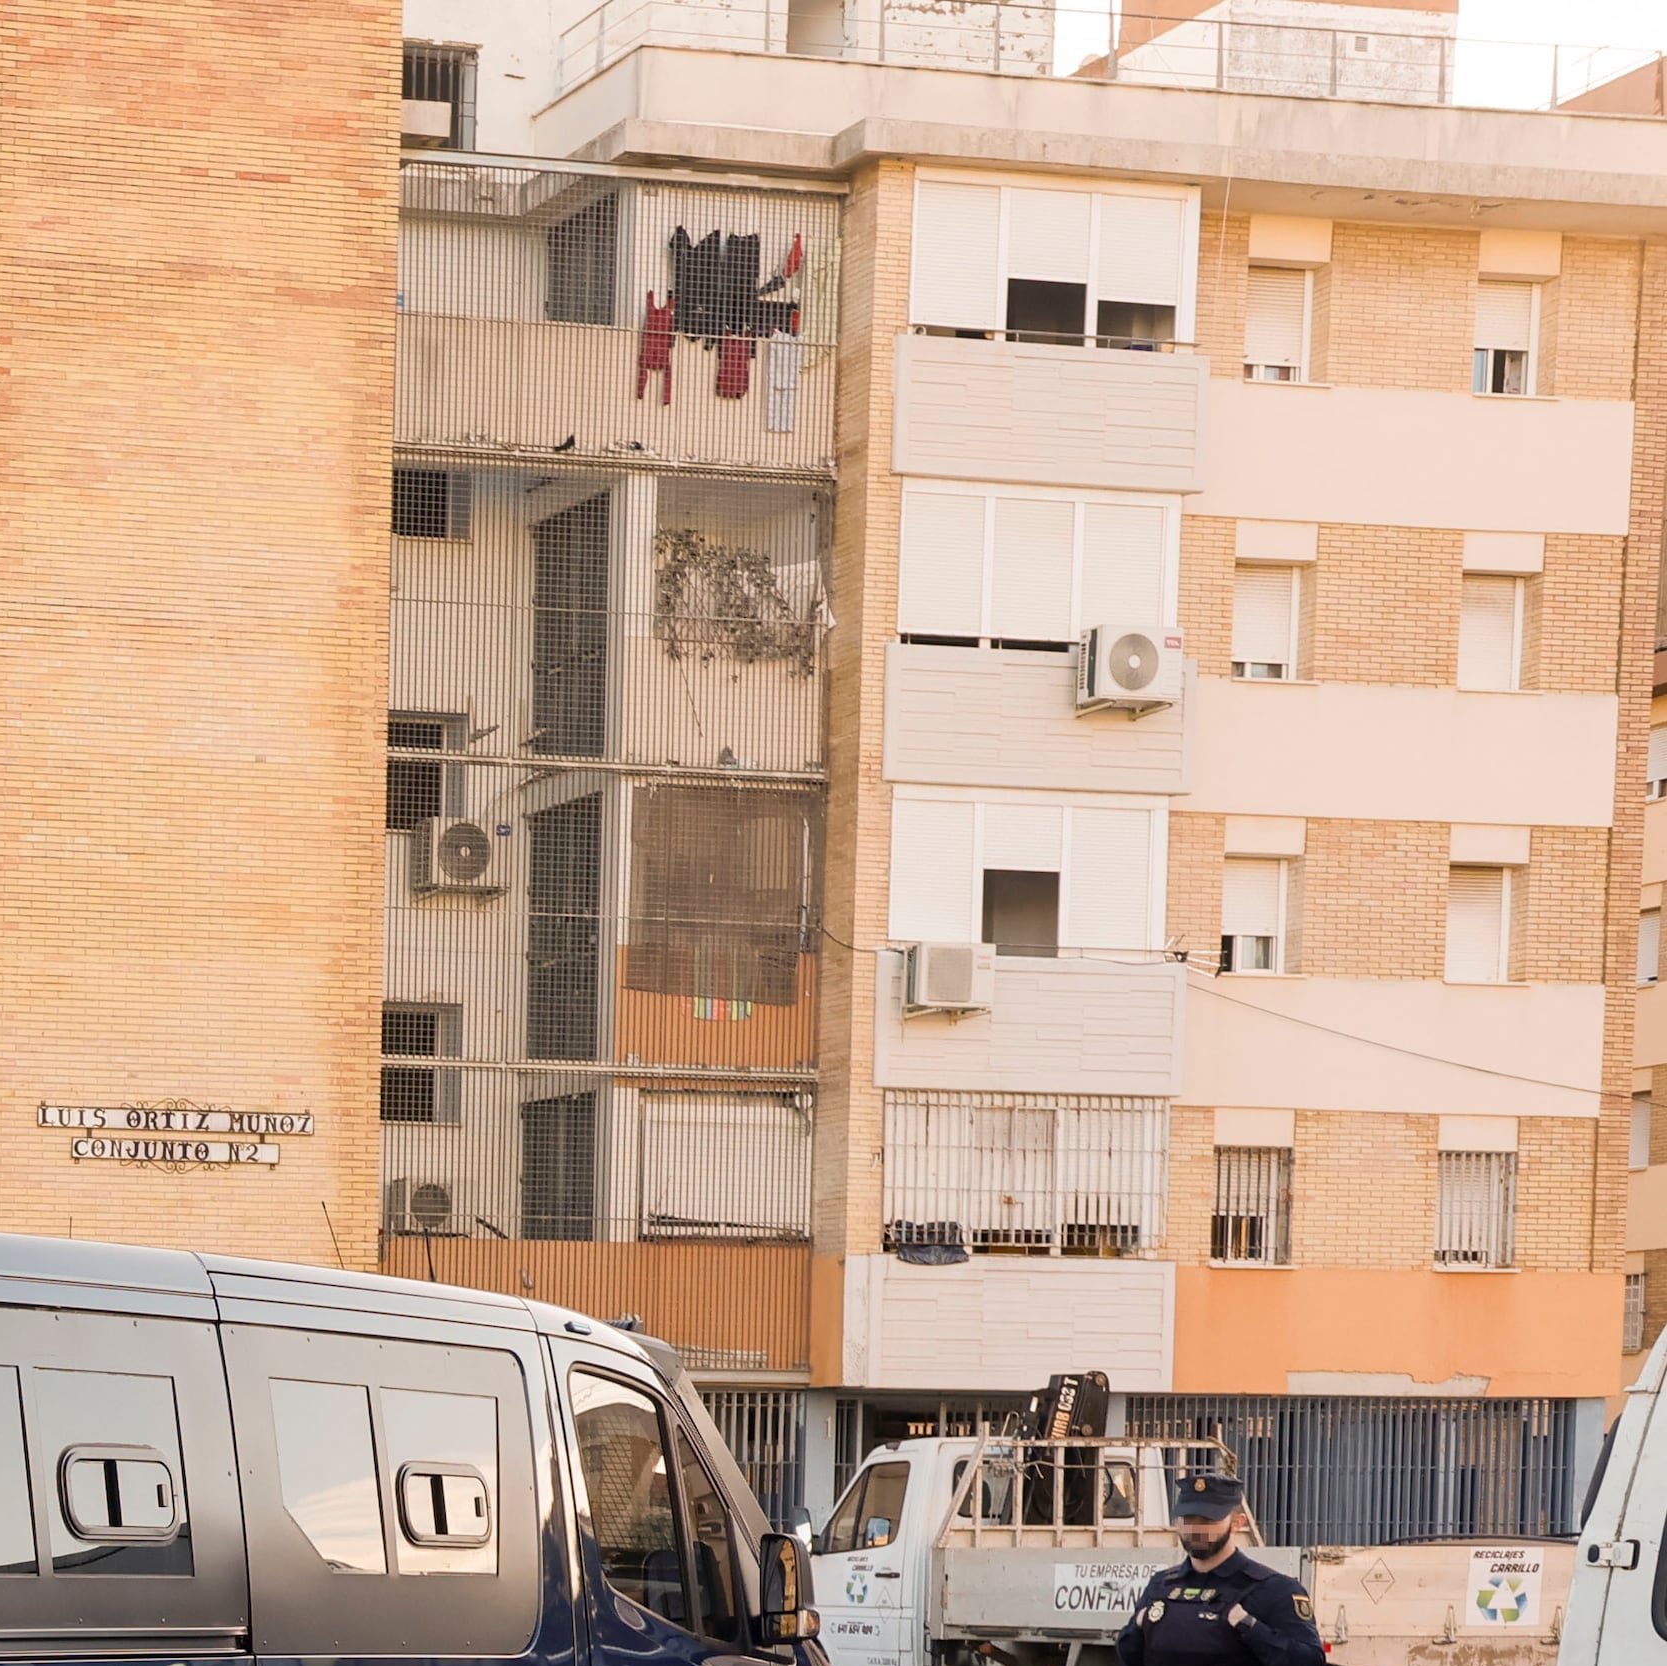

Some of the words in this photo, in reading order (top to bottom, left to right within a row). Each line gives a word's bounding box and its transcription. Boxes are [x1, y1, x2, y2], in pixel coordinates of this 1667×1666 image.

[40, 1106, 106, 1128] LUIS
[126, 1110, 210, 1131] ORTIZ
[73, 1138, 210, 1161] CONJUNTO
[1473, 1550, 1525, 1560] RECICLAJES
[1075, 1564, 1088, 1578] TU
[1089, 1564, 1139, 1578] EMPRESA
[1490, 1563, 1539, 1573] CARRILLO
